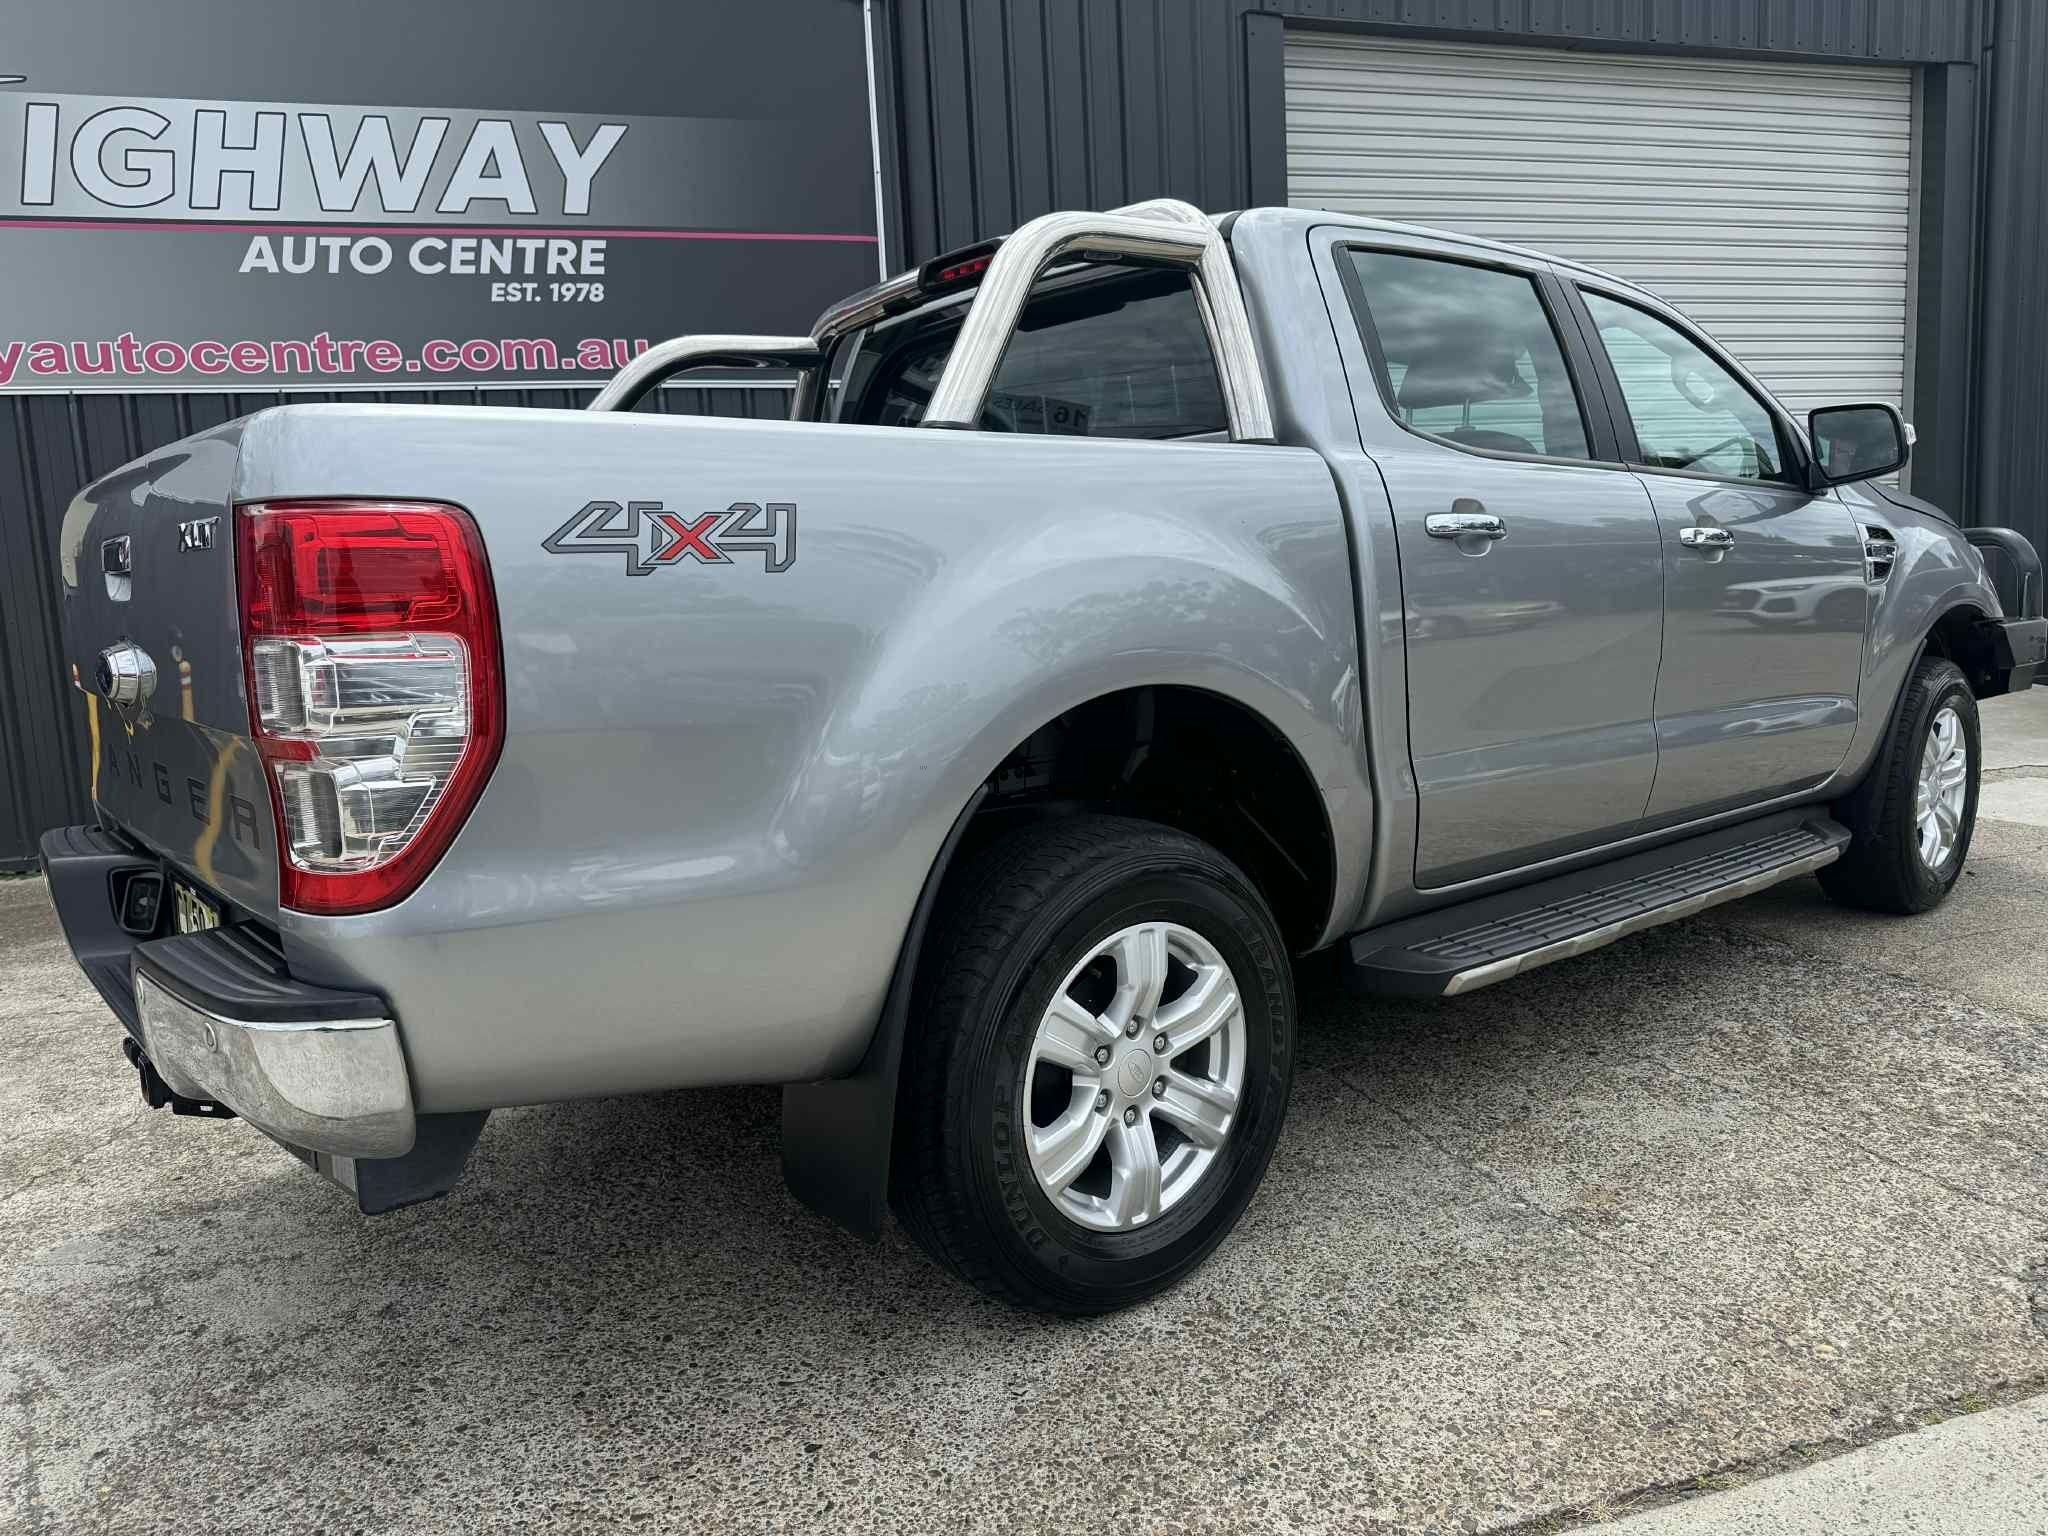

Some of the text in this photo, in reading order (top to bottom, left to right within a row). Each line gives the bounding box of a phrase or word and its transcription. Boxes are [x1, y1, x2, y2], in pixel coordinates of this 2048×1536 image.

[20, 103, 629, 216] IGHWAY
[239, 236, 606, 275] AUTO CENTRE
[491, 282, 605, 302] EST. 1978
[176, 516, 222, 552] XLT
